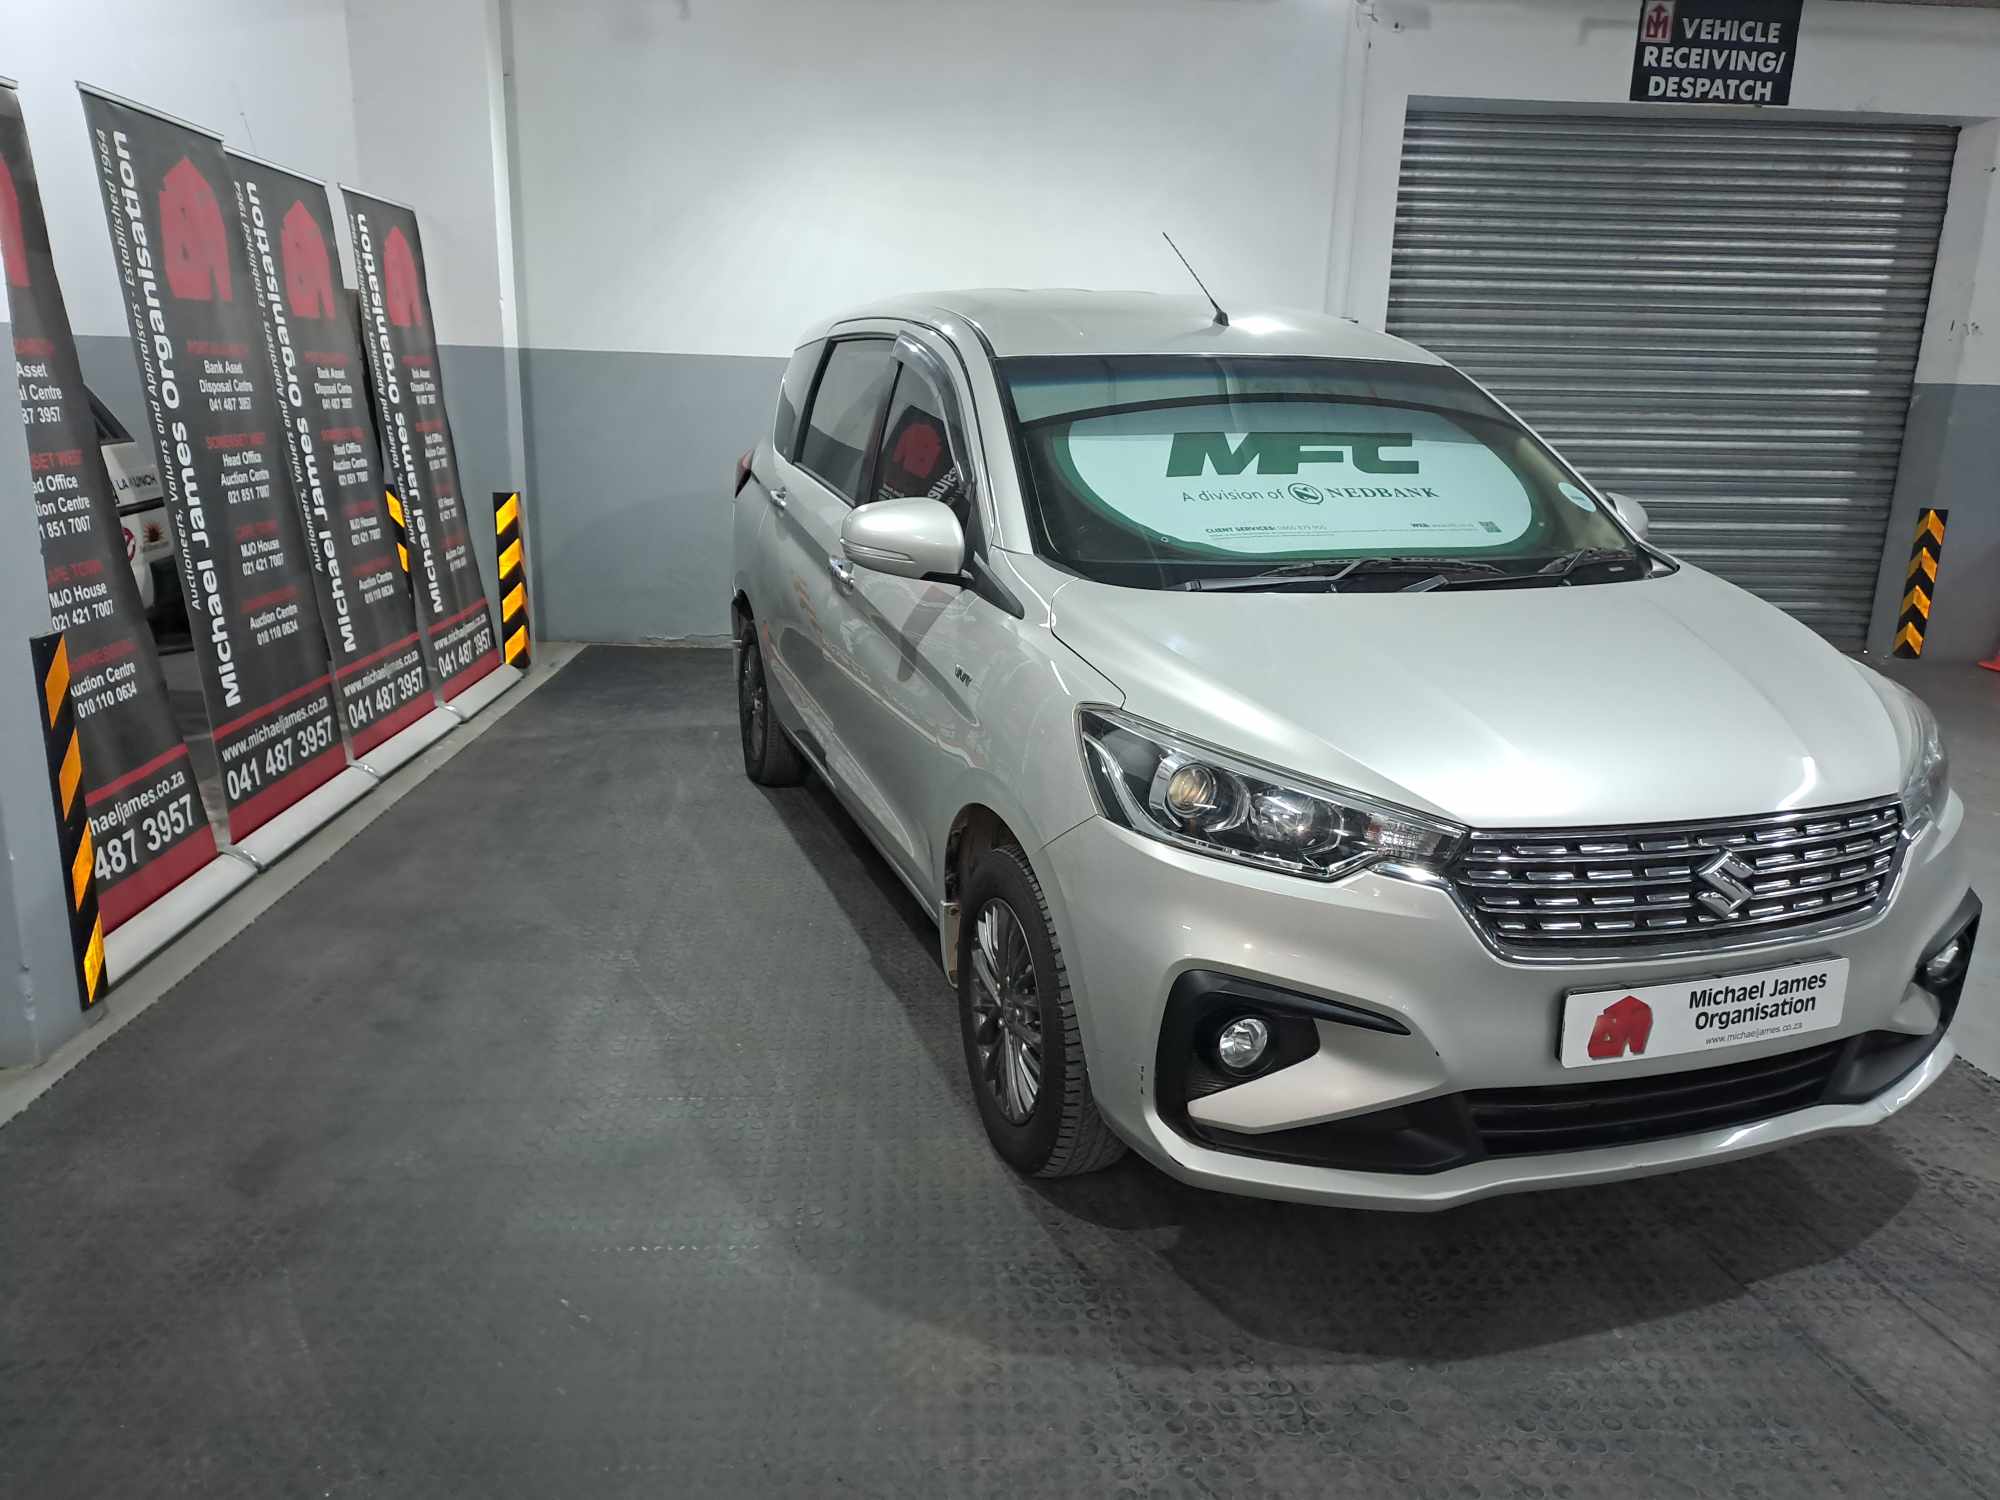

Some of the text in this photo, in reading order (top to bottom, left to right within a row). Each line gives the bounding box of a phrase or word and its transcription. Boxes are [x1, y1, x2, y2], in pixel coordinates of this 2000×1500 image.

[1682, 17, 1781, 44] VEHICLE
[1643, 45, 1786, 73] RECEIVING/
[1648, 75, 1772, 102] DESPATCH
[105, 179, 135, 286] Established
[357, 213, 400, 404] Organisation
[132, 303, 158, 396] Appraisers
[16, 362, 48, 378] Asset
[199, 379, 232, 395] Disposal
[29, 383, 62, 400] Centre
[21, 406, 61, 424] 87 3957
[113, 131, 241, 708] Michael James Organisation
[150, 400, 165, 434] and
[246, 182, 357, 653] Michael James Organisation
[160, 440, 179, 501] Valuers
[394, 412, 421, 501] James
[1166, 431, 1419, 477] MFC
[46, 473, 78, 491] Office
[1182, 487, 1439, 503] A division of NEDBANK
[57, 495, 90, 513] Centre
[47, 518, 67, 538] 851
[68, 515, 91, 534] 7007
[175, 510, 202, 610] Auctioneers,
[412, 508, 444, 614] Michael
[49, 582, 108, 609] MJO House
[52, 599, 114, 631] 021 421 7007
[106, 661, 136, 683] Centre
[438, 650, 457, 678] 041
[458, 638, 472, 664] 487
[77, 680, 138, 719] 010 110 0634
[348, 667, 424, 729] 041 487 3957
[222, 696, 328, 762] www.michaeljames.co.za
[226, 716, 332, 801] 041 487 3957
[89, 769, 185, 837] haeljames.co.za
[93, 793, 195, 881] 487 3957
[1689, 971, 1827, 1009] Michael James
[1694, 995, 1816, 1031] Organisation
[1705, 1022, 1803, 1045] www.michaeljames.co.za
